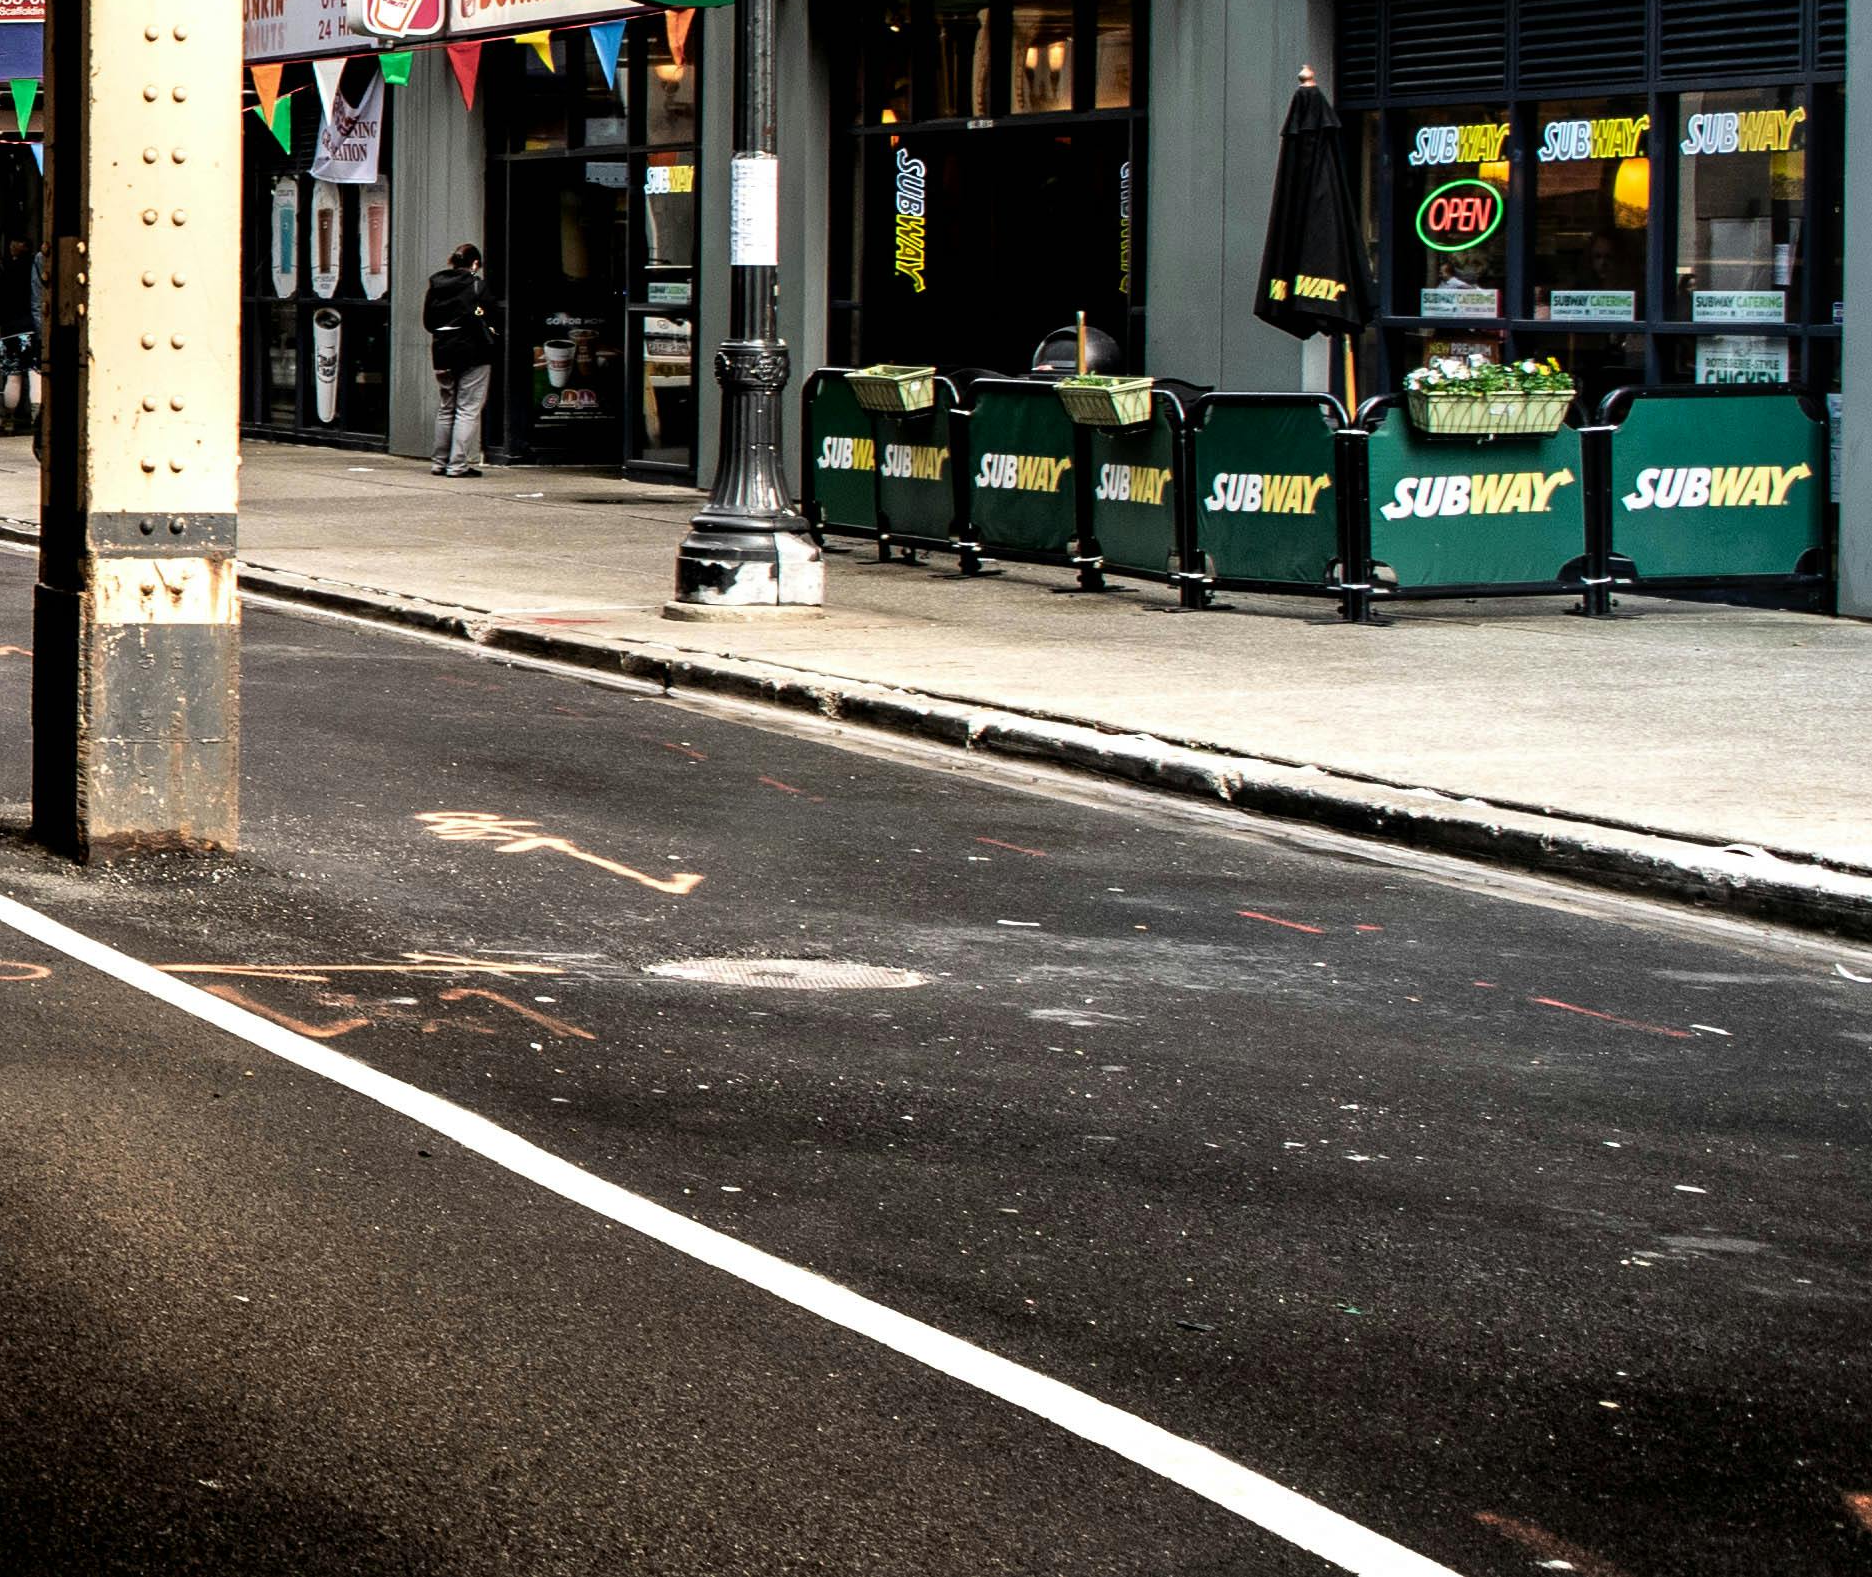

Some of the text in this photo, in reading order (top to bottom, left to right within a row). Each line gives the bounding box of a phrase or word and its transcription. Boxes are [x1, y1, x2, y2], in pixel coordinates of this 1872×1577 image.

[318, 18, 332, 41] 24
[1409, 122, 1510, 166] SUBWAY
[1538, 114, 1649, 163] SUBWAY
[1680, 107, 1805, 156] SUBWAY
[895, 148, 926, 293] SUBWAY
[1428, 197, 1492, 233] OPEN
[1294, 274, 1347, 302] WAY
[1553, 295, 1633, 307] SUBWAY CATERING
[1696, 296, 1783, 308] SUBWAY CATERING
[1429, 342, 1492, 356] NEW PREMIUM
[816, 436, 875, 471] SUBWA
[880, 444, 950, 481] SUBWAY
[975, 452, 1072, 493] SUBWAY
[1095, 463, 1172, 505] SUBWAY
[1203, 472, 1333, 515] SUBWAY
[1380, 467, 1576, 521] SUBWAY
[1621, 462, 1813, 514] SUBWAY
